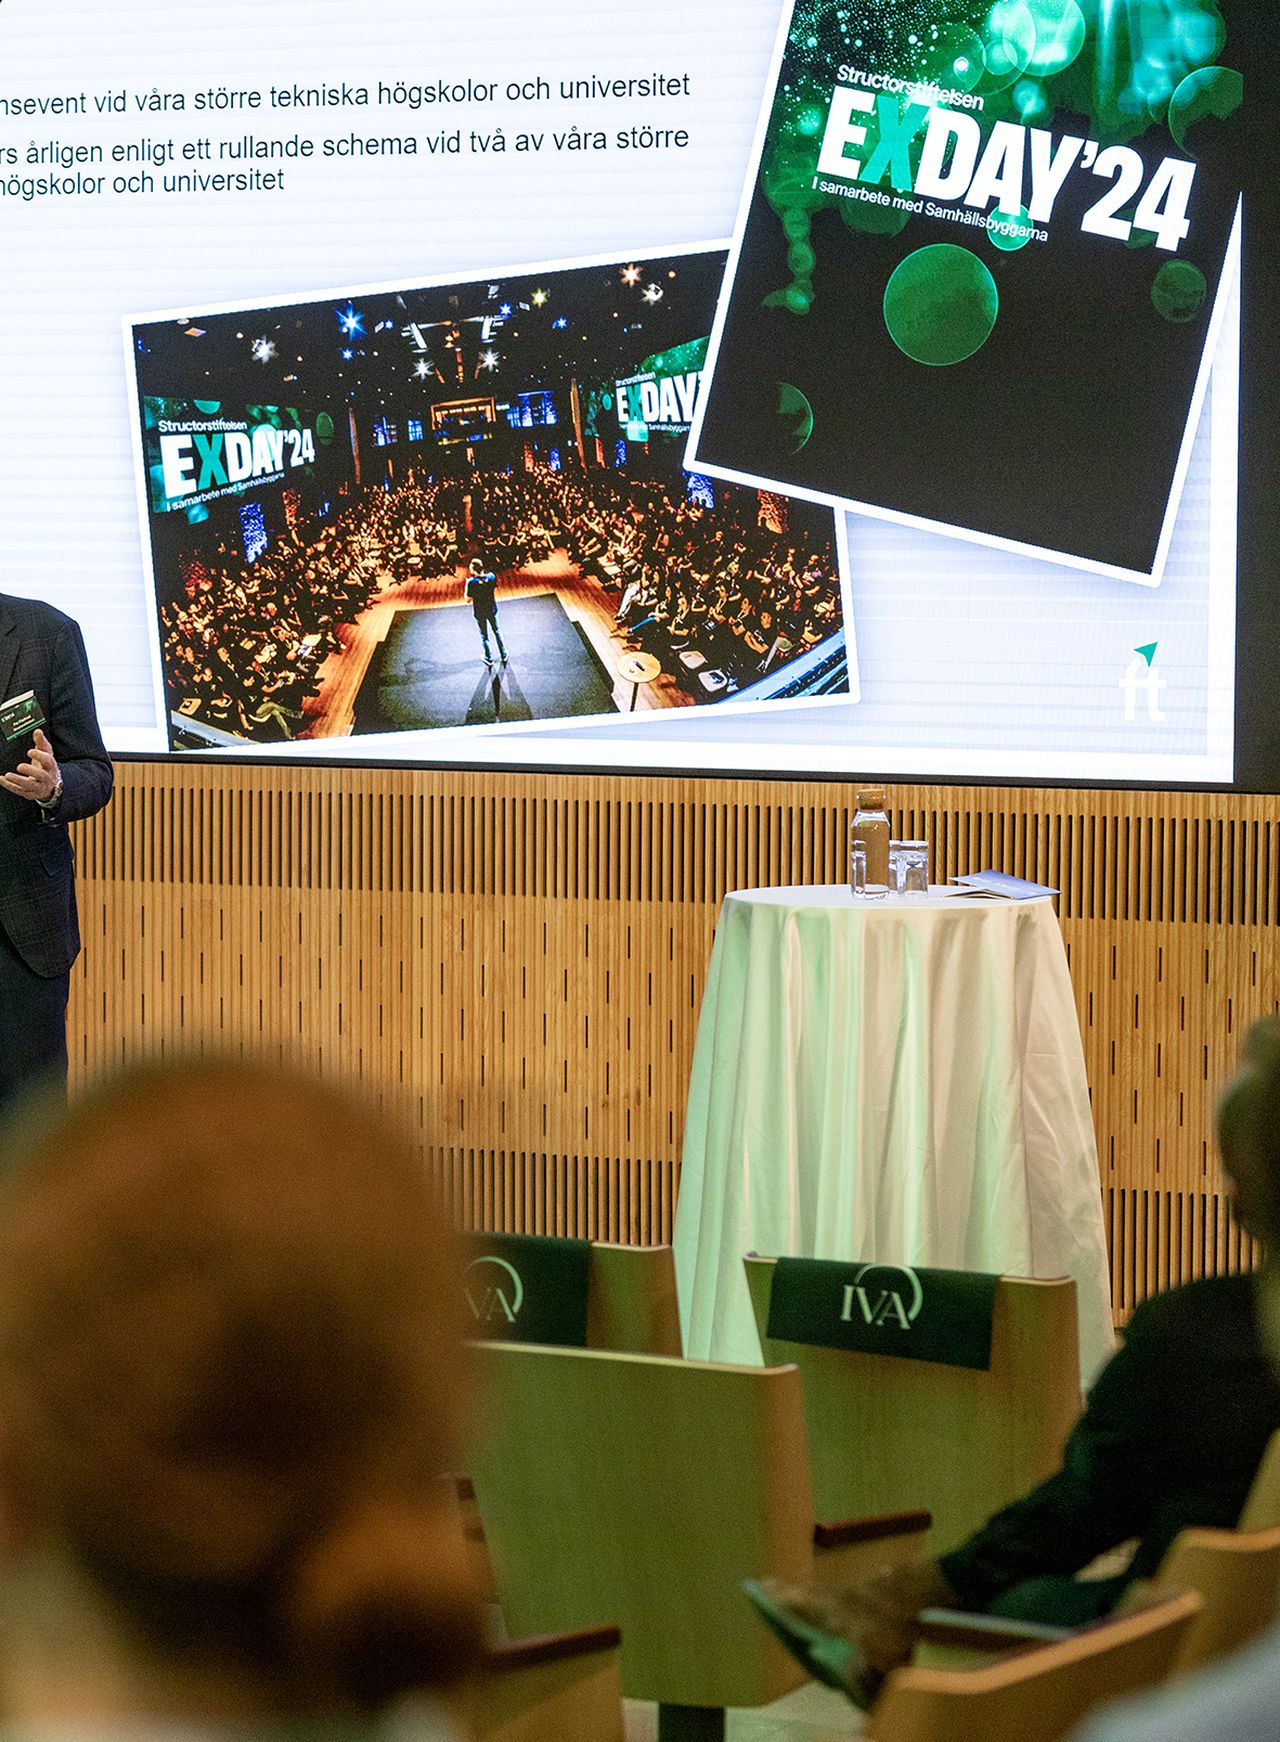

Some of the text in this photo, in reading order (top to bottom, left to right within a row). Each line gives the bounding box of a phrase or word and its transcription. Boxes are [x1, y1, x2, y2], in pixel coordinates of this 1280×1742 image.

[94, 89, 126, 113] vid
[135, 88, 185, 111] våra
[194, 86, 261, 110] större
[270, 83, 368, 108] tekniska
[378, 79, 498, 109] högskolor
[506, 76, 550, 101] och
[560, 73, 690, 98] universitet
[837, 64, 985, 111] Structorstiftelsen
[26, 140, 103, 168] årligen
[112, 138, 174, 166] enligt
[182, 138, 211, 160] ett
[220, 134, 314, 159] rullande
[323, 133, 417, 156] schema
[426, 130, 460, 153] vid
[470, 128, 506, 152] två
[515, 133, 544, 151] av
[553, 125, 607, 150] våra
[616, 126, 690, 149] större
[816, 85, 1197, 252] EXDAY'24
[113, 170, 154, 193] och
[163, 168, 284, 192] universitet
[812, 176, 1050, 242] I samarbete med Samhällsbyggarna
[840, 1284, 911, 1330] IVA
